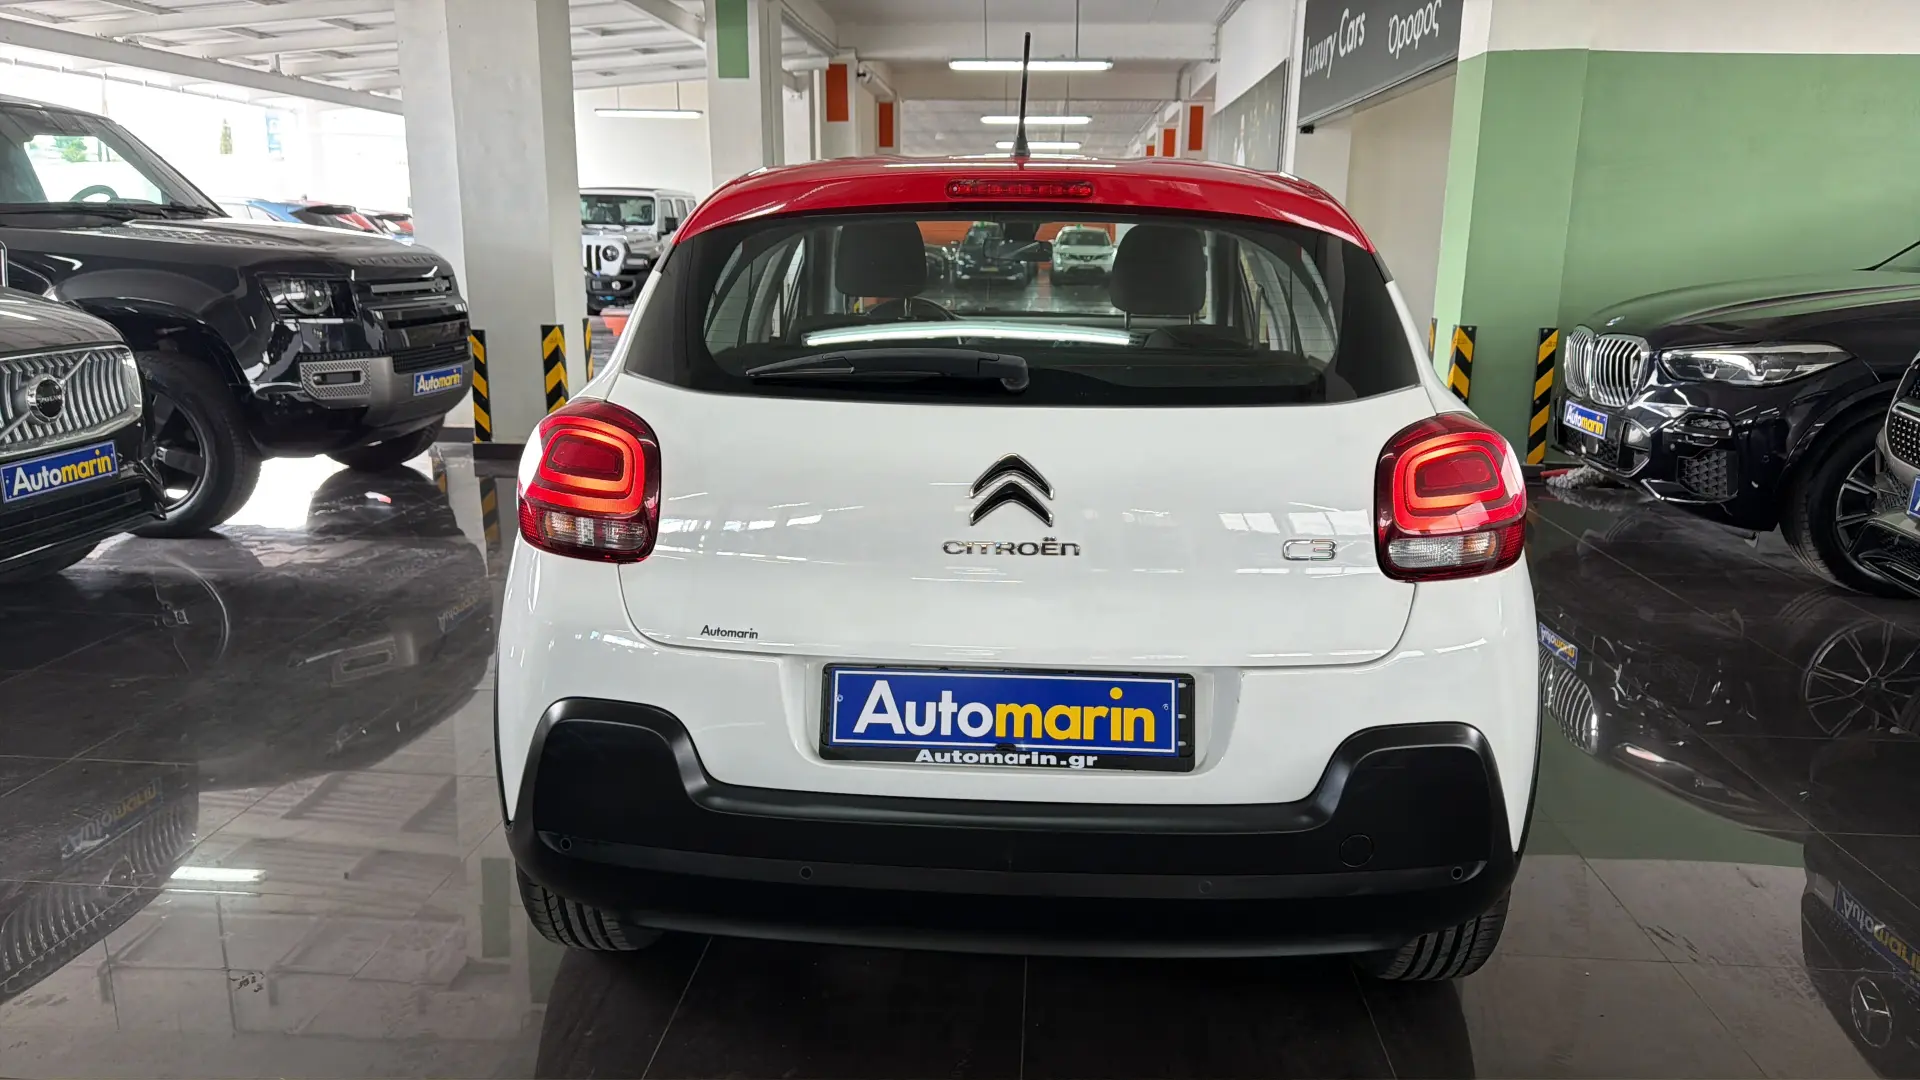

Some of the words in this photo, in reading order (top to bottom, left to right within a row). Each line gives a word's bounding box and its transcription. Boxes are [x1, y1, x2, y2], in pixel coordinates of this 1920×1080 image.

[1304, 37, 1337, 79] Luxury
[1338, 8, 1366, 57] Cars
[417, 368, 460, 392] Automarin
[1566, 405, 1604, 435] Automarin
[13, 449, 112, 496] Automarin
[1283, 539, 1337, 561] C3
[700, 624, 758, 639] Automarin
[853, 680, 1155, 742] Automarin
[915, 749, 1098, 768] Automarin.gr
